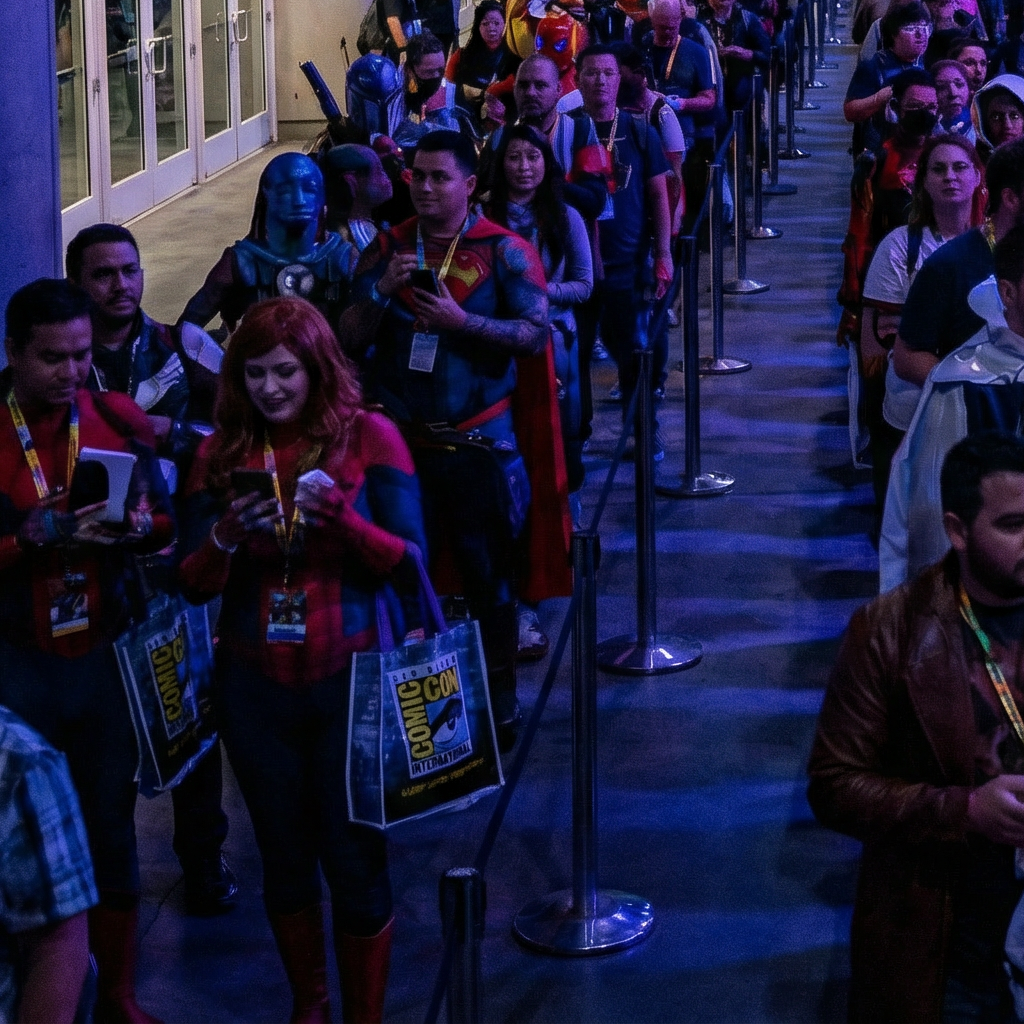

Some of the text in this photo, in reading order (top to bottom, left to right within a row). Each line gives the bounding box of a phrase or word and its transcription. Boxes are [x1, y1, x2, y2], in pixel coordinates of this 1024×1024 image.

[151, 644, 182, 722] COMIC
[397, 679, 434, 761] COMIC
[423, 666, 459, 702] CON
